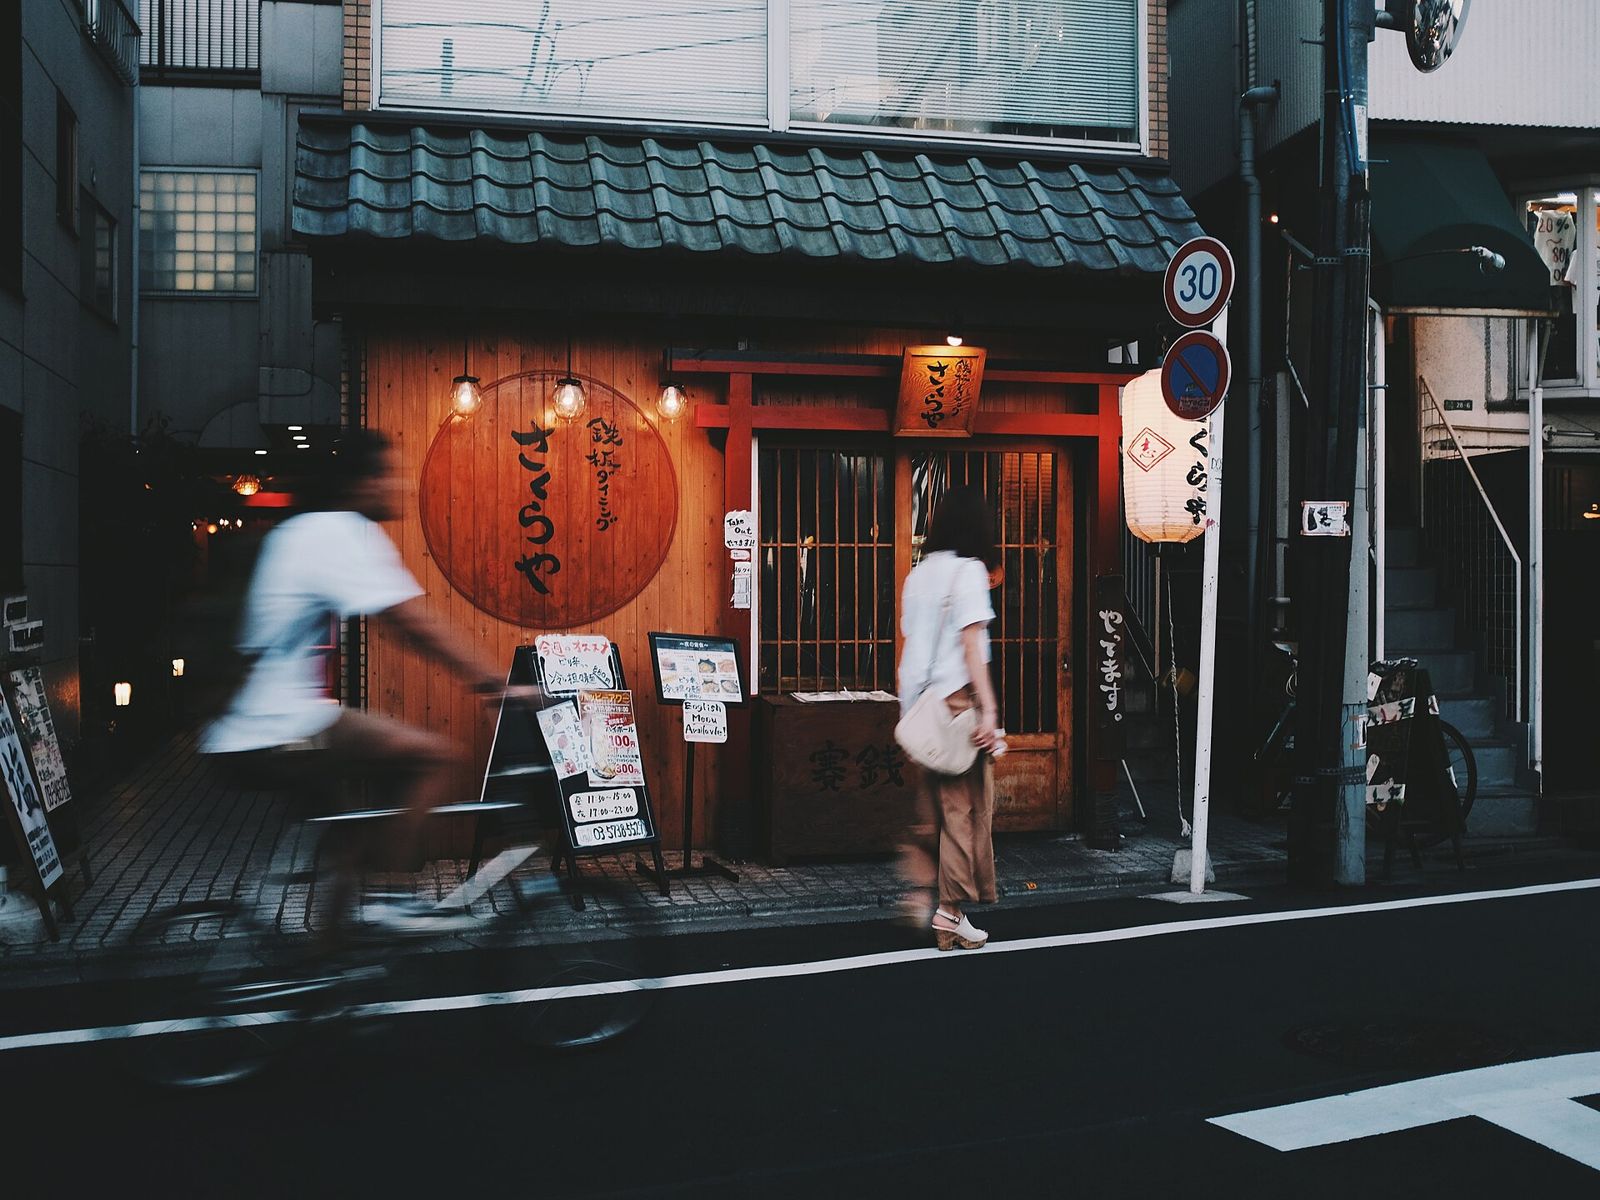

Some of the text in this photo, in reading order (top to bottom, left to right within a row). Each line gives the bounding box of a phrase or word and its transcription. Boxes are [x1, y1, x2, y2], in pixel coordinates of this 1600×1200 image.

[1180, 262, 1217, 302] 30
[921, 361, 949, 428] さくらや
[585, 417, 624, 532] 鉄板ダイニング
[511, 420, 561, 595] さくらや
[726, 518, 745, 527] Take
[734, 526, 753, 535] Out
[1099, 609, 1123, 722] やってます。
[684, 701, 722, 713] English
[692, 713, 718, 724] Menu
